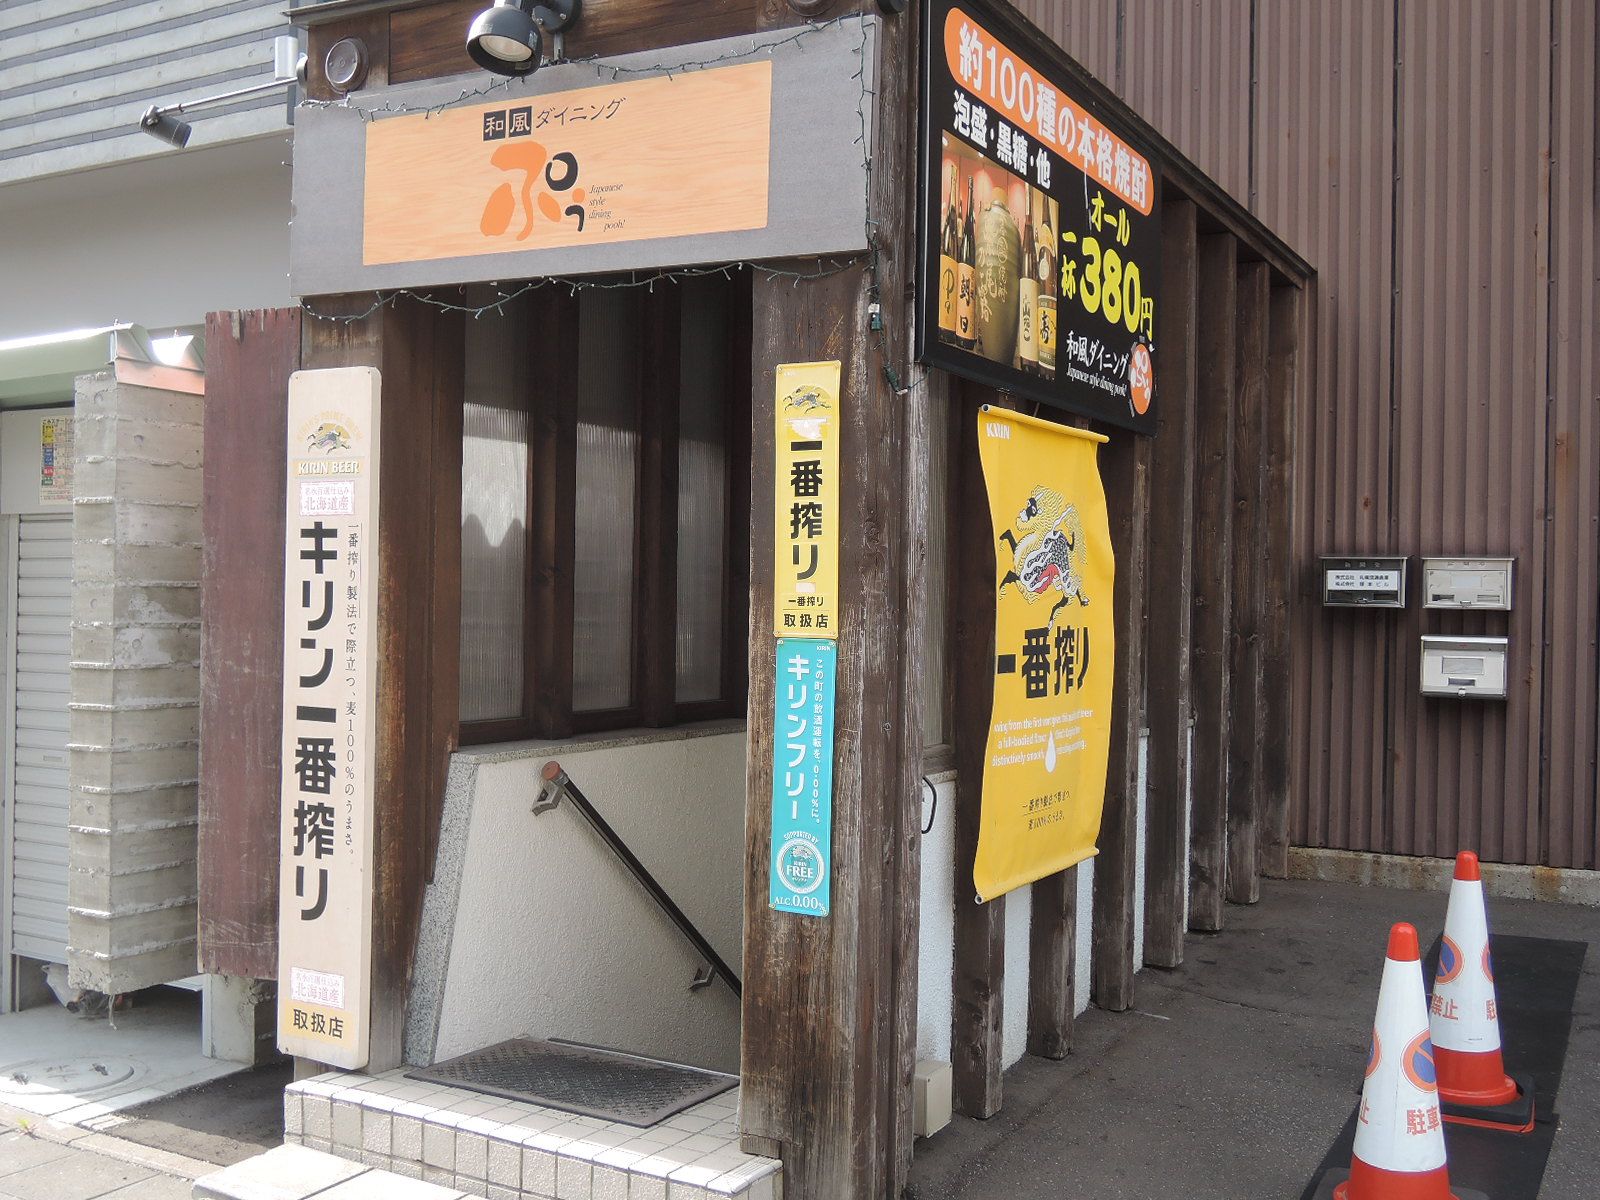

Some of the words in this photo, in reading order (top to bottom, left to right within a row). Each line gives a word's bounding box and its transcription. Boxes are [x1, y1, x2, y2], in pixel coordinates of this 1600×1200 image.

[484, 97, 627, 138] 和風ダイニング
[958, 21, 1148, 209] 約100種の本格焼酎
[589, 184, 624, 195] Japanese
[589, 196, 606, 208] style
[588, 209, 612, 219] dining
[1091, 191, 1131, 248] オール
[1061, 230, 1078, 300] 一杯
[1066, 329, 1130, 379] 和風ダイニング
[299, 461, 329, 475] KIRIN
[332, 461, 360, 474] BEER
[304, 495, 349, 511] 北海道産
[790, 440, 823, 581] 一番搾り
[788, 596, 824, 607] 一番搾り
[783, 613, 829, 629] 取扱店
[997, 624, 1090, 699] 一番搾り
[293, 521, 338, 921] キリン一番搾り
[785, 654, 811, 820] キリンフリー
[786, 864, 814, 879] FREE
[293, 1008, 344, 1039] 取扱店
[1406, 1105, 1440, 1135] 駐車
